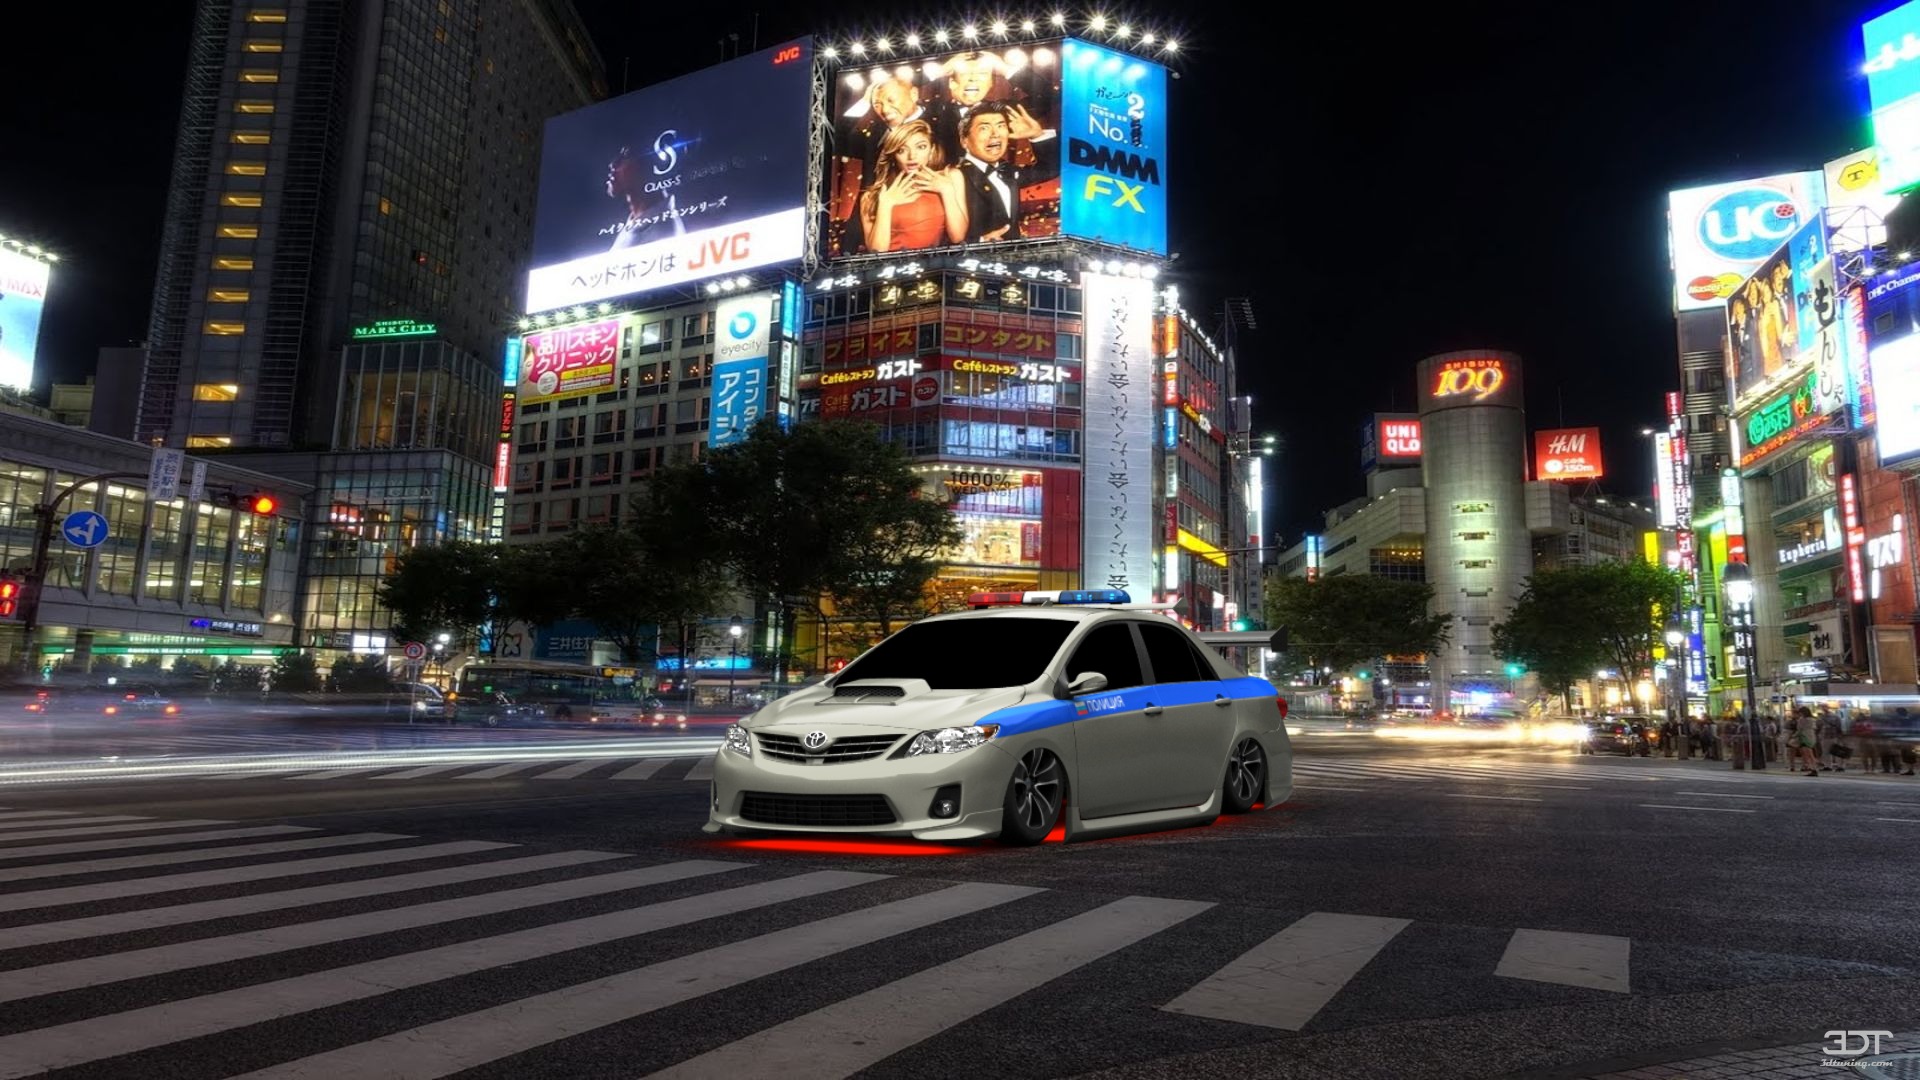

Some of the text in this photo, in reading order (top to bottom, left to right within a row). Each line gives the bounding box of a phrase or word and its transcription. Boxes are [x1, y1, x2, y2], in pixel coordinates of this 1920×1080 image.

[774, 46, 801, 64] JVC
[1089, 113, 1129, 144] No.
[1068, 136, 1161, 186] DMM
[643, 173, 682, 193] CLASS-S
[1084, 173, 1146, 214] FX
[570, 231, 751, 289] ヘッドホンは JVC
[1867, 283, 1887, 302] DHC
[355, 323, 436, 336] MARK CITY
[944, 325, 1052, 352] コンタクト
[537, 326, 617, 357] 品川スキン
[720, 339, 763, 357] eyecity
[826, 329, 913, 360] プライス
[536, 344, 616, 375] クリニック
[877, 358, 923, 381] ガスト
[1445, 360, 1501, 370] SHIBUYA
[1020, 362, 1072, 383] ガスト
[1433, 367, 1504, 401] 109
[715, 371, 741, 449] アイシ
[850, 385, 907, 412] ガスト
[1385, 424, 1417, 438] UNI
[1386, 438, 1421, 454] QLO
[1548, 433, 1586, 455] H&M
[950, 471, 1011, 490] 1000%
[1778, 538, 1826, 563] Euphoria
[1086, 695, 1126, 713] ПОЛИЦИЯ
